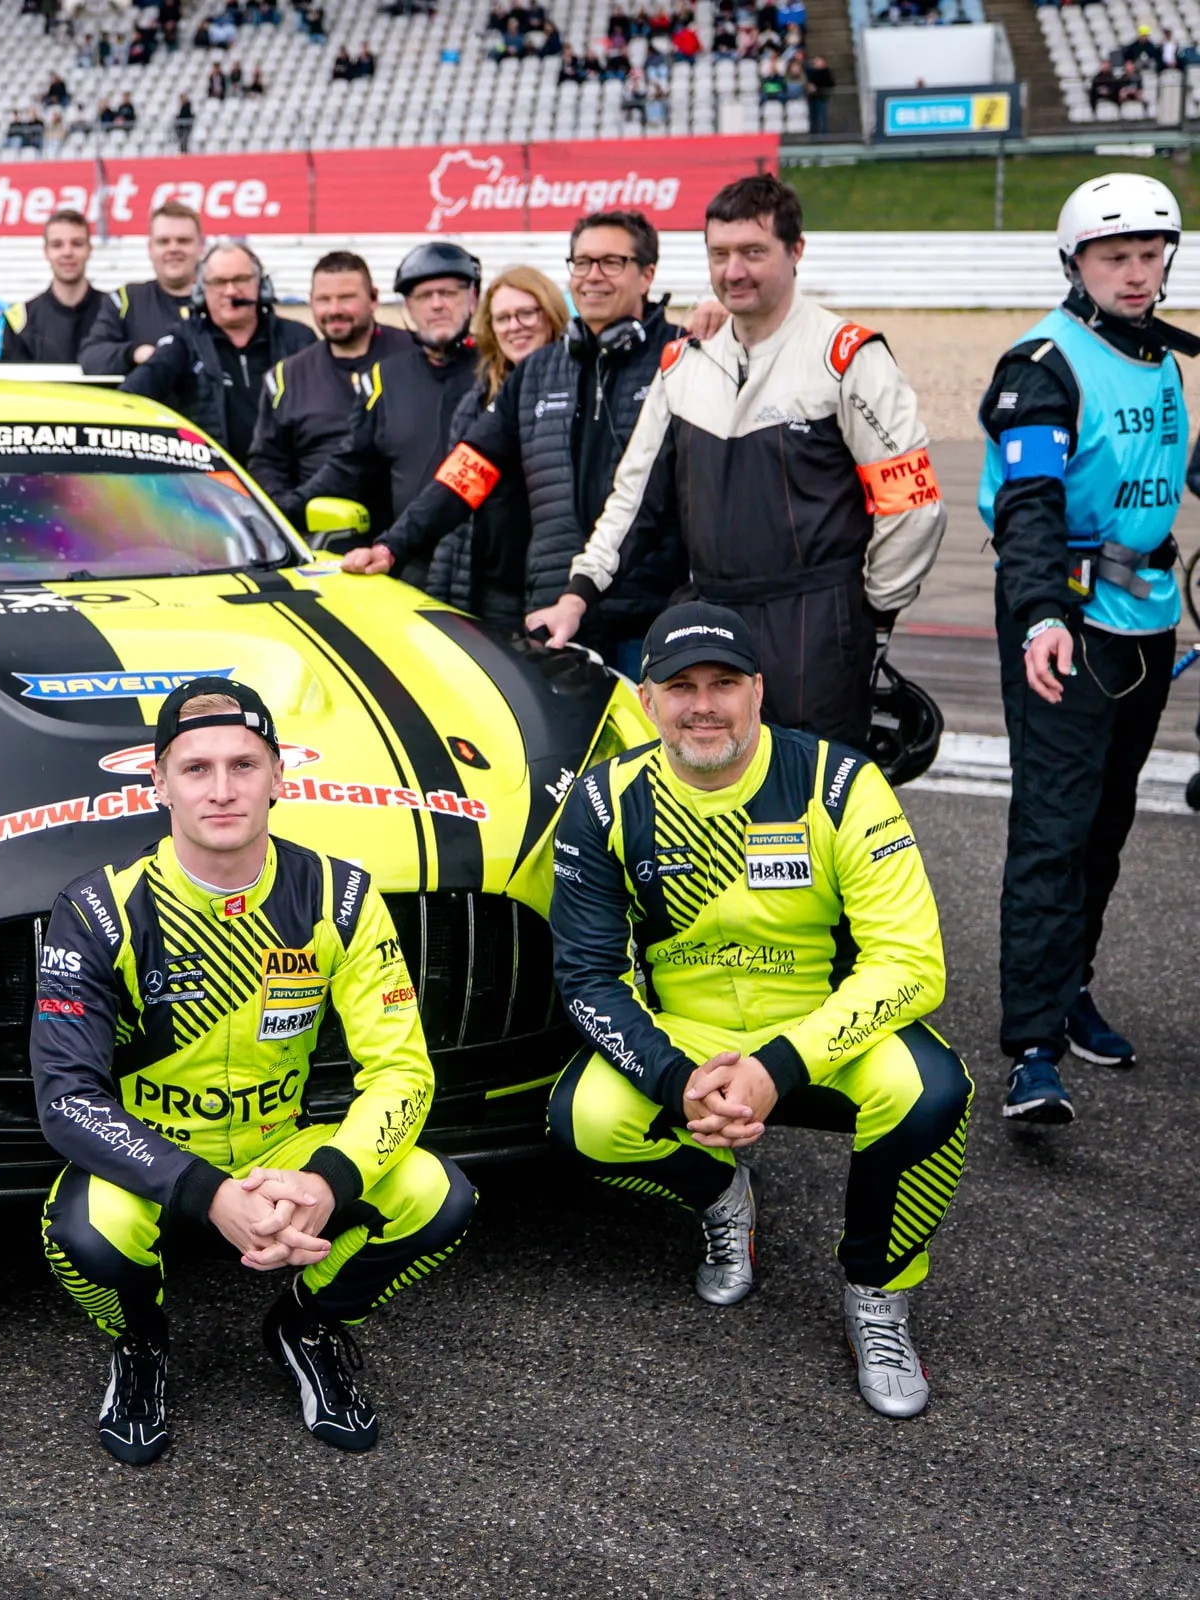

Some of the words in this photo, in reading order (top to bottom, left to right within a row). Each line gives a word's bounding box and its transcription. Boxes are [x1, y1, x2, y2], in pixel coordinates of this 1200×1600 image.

[150, 177, 281, 219] race.
[471, 171, 680, 214] nürburgring
[1114, 406, 1154, 435] 139
[31, 446, 72, 455] REAL
[74, 446, 134, 459] DRIVING
[83, 427, 212, 462] TURISMO
[914, 475, 927, 488] Q
[908, 487, 937, 505] 1741
[688, 626, 734, 640] AMG
[825, 757, 856, 807] MARINA
[583, 774, 611, 827] MARINA
[751, 835, 801, 844] RAVENOL
[749, 862, 786, 879] H&R
[336, 870, 361, 926] MARINA
[80, 886, 121, 946] MARINA
[40, 946, 82, 972] TMS
[655, 948, 744, 967] Schnitzel
[746, 946, 795, 970] Alm
[273, 988, 320, 998] RAVENOL
[263, 1015, 297, 1034] H&R
[828, 1002, 895, 1062] Schnitzel
[895, 982, 924, 1017] Alm
[569, 999, 620, 1054] Schnitzel
[613, 1051, 644, 1077] Alm
[51, 1095, 125, 1144] Schnitzel
[112, 1138, 155, 1166] Alm
[858, 1302, 892, 1315] HEYER
